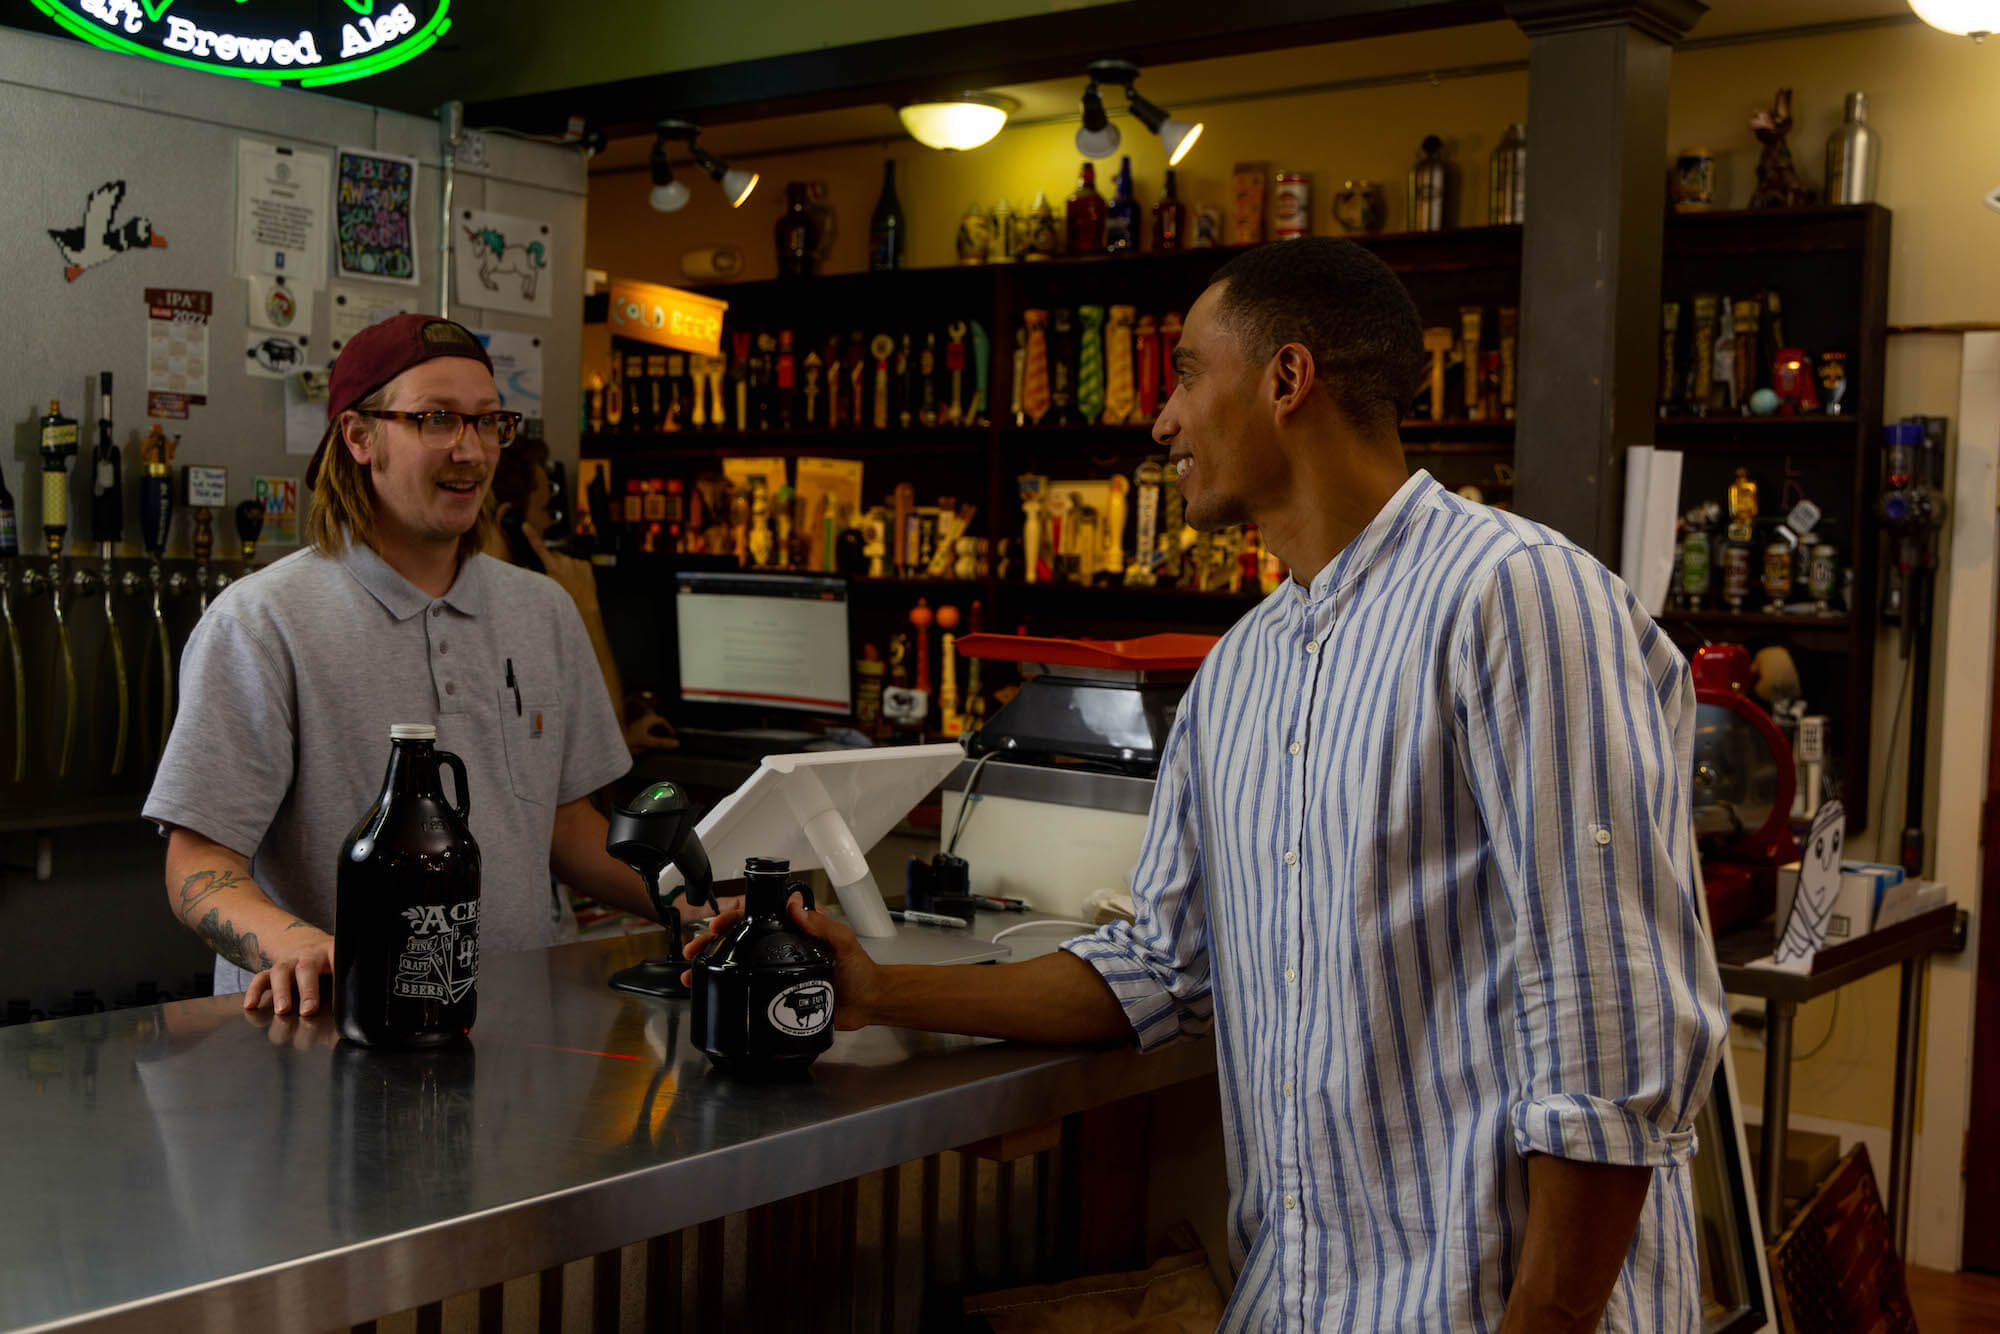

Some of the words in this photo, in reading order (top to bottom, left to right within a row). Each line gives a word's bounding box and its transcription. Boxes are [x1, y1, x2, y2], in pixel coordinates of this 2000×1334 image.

[163, 15, 322, 65] Brewed
[341, 4, 416, 57] Ales
[167, 291, 193, 309] IPA
[613, 296, 665, 330] COLD
[409, 940, 433, 953] FINE
[402, 957, 430, 972] CRAFT
[401, 982, 444, 996] BEERS
